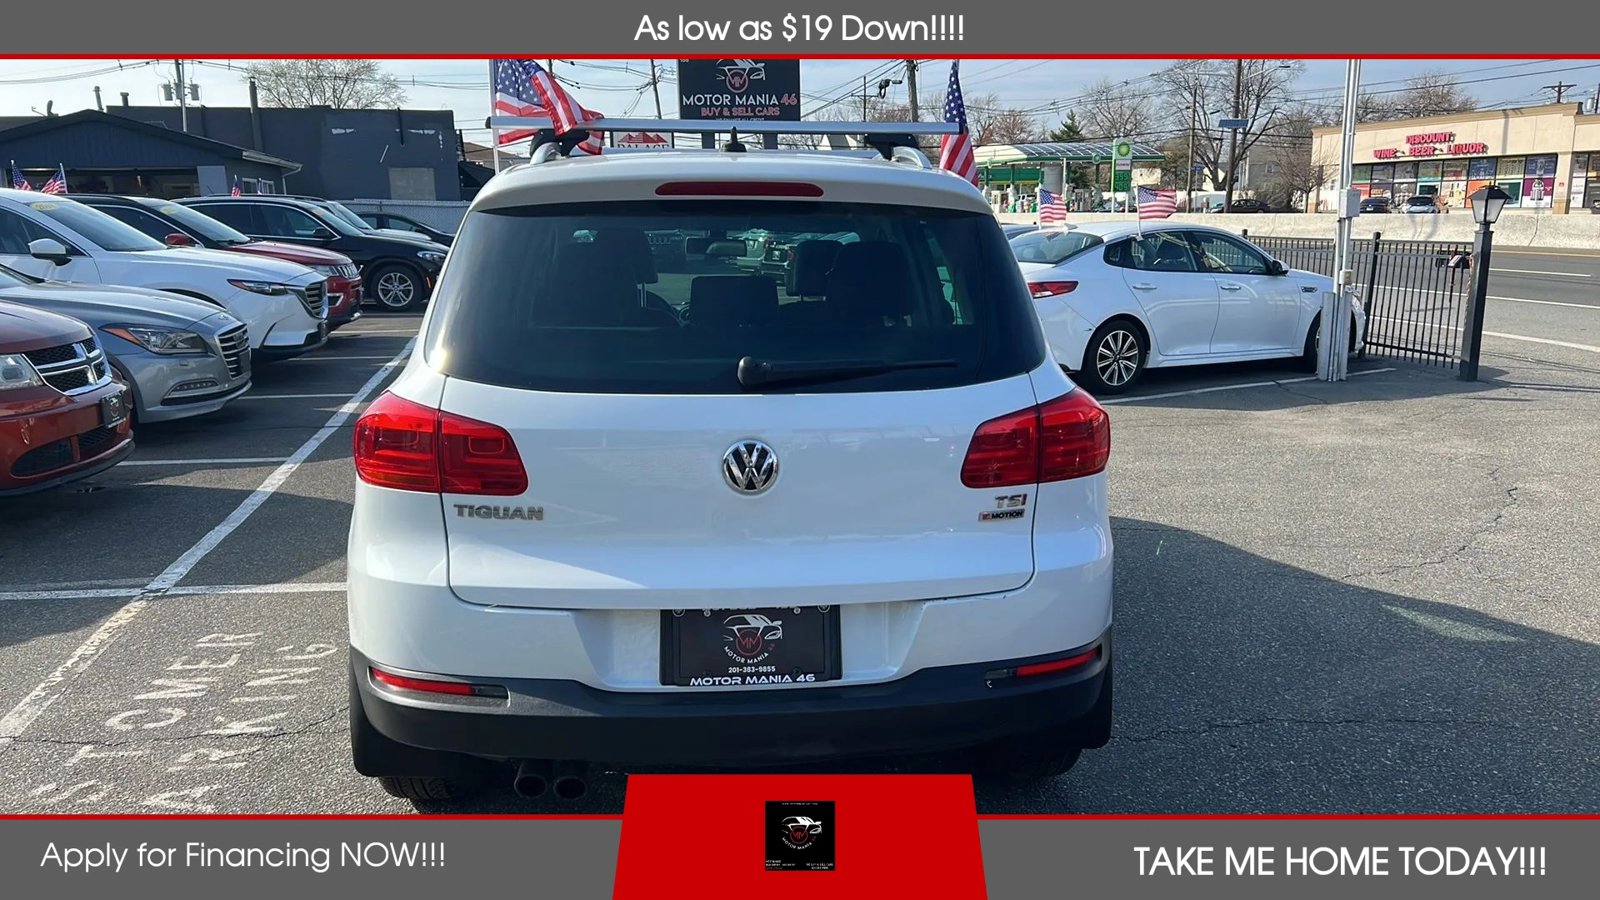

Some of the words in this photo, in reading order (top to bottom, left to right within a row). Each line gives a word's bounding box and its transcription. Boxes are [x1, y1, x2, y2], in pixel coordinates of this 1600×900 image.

[683, 95, 731, 105] MOTOR
[736, 94, 778, 105] MANIA
[780, 93, 798, 105] 46
[701, 107, 720, 116] BUY
[722, 107, 730, 116] &
[732, 107, 754, 116] SELL
[755, 106, 780, 116] CARS
[1406, 132, 1453, 145] DISCOUNT
[1373, 148, 1398, 159] WINE
[1409, 146, 1436, 156] BEER
[1447, 143, 1486, 154] LIQUOR
[995, 493, 1027, 508] TSI
[453, 503, 544, 521] TIGUAN
[724, 646, 746, 663] MOTOR
[747, 652, 769, 664] MANIA
[690, 677, 742, 687] MOTOR
[745, 674, 793, 685] MANIA
[796, 673, 816, 683] 46
